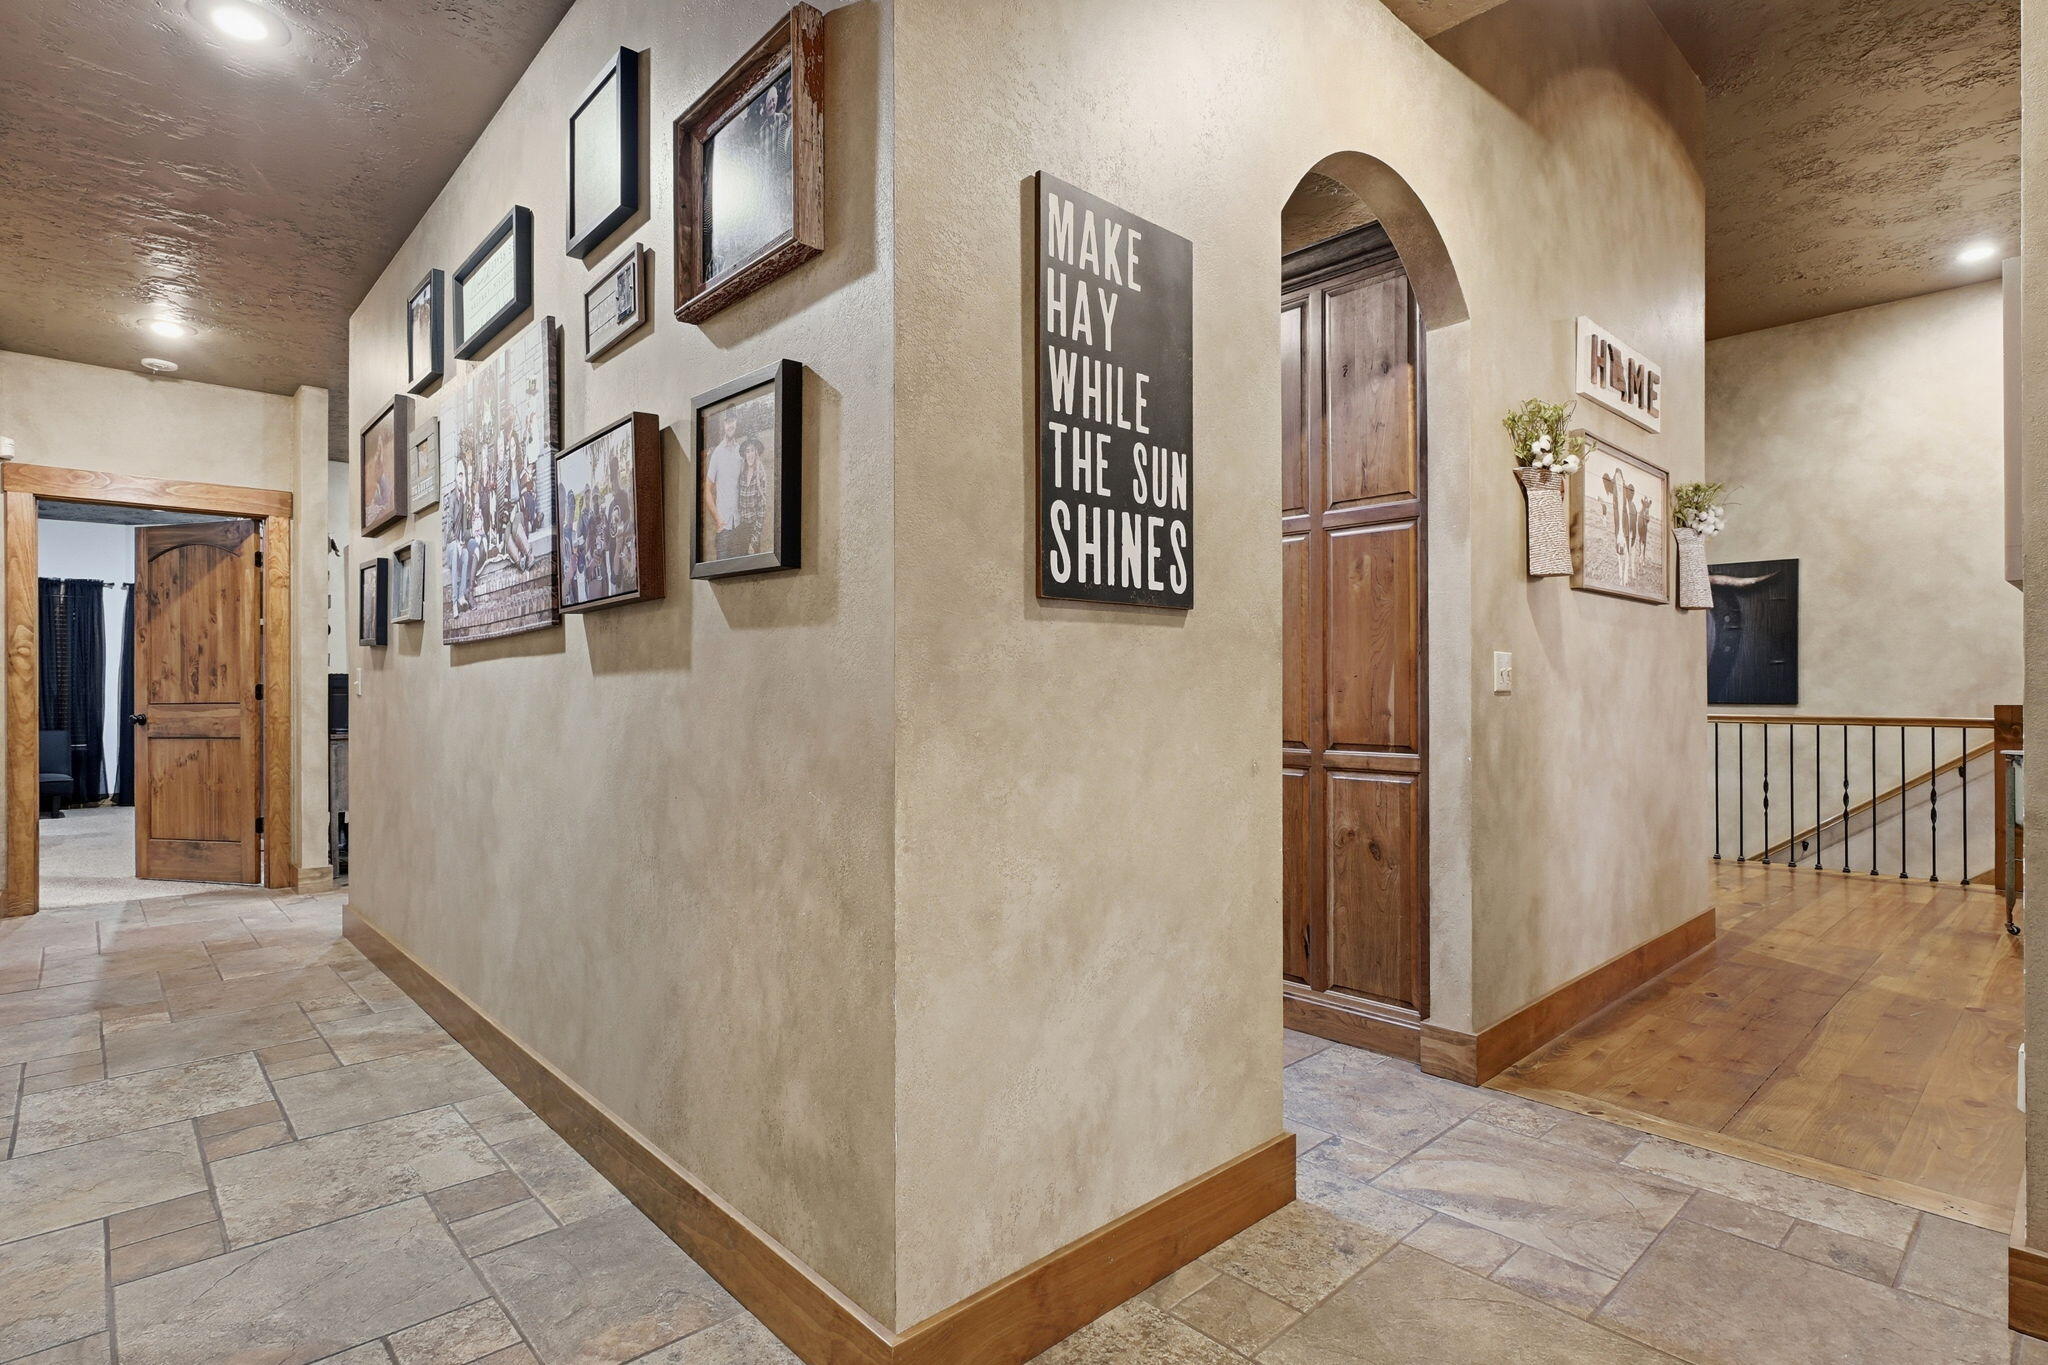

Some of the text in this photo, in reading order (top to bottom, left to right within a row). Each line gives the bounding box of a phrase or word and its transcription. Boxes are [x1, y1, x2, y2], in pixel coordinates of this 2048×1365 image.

[1048, 193, 1142, 292] MAKE
[1047, 267, 1118, 352] HAY
[1048, 345, 1150, 435] WHILE
[1591, 334, 1660, 418] HME
[1049, 422, 1187, 511] THE SUN
[1050, 500, 1188, 595] SHINES
